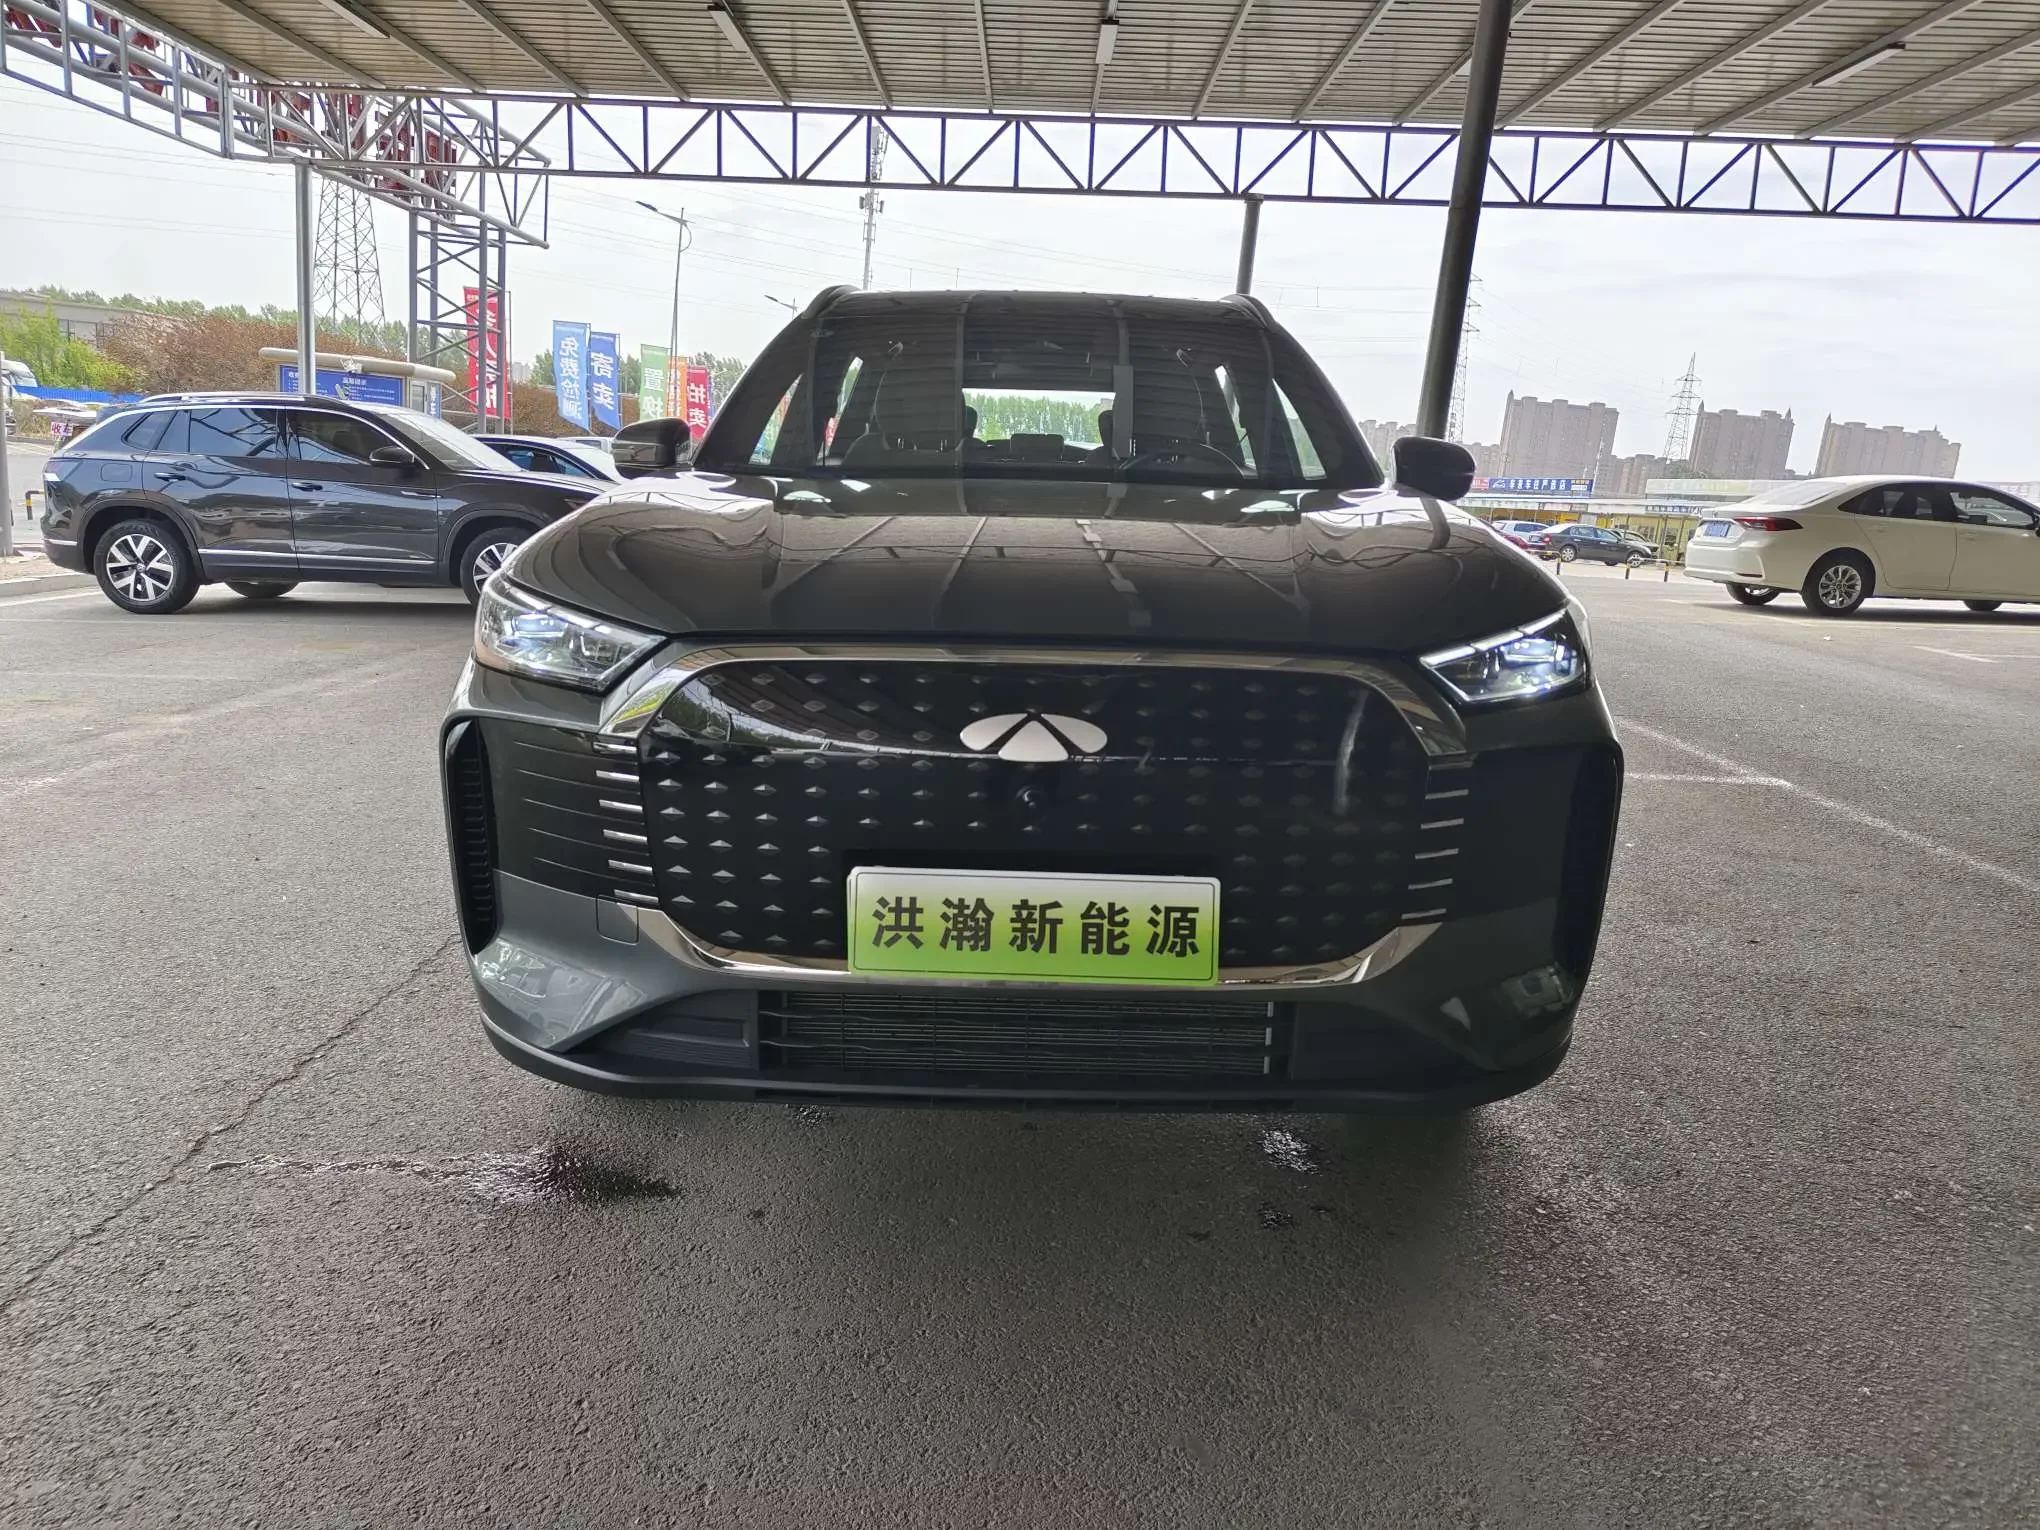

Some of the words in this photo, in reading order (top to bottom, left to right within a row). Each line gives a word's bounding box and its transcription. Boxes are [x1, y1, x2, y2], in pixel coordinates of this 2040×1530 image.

[871, 895, 1201, 959] 洪瀚新能源
